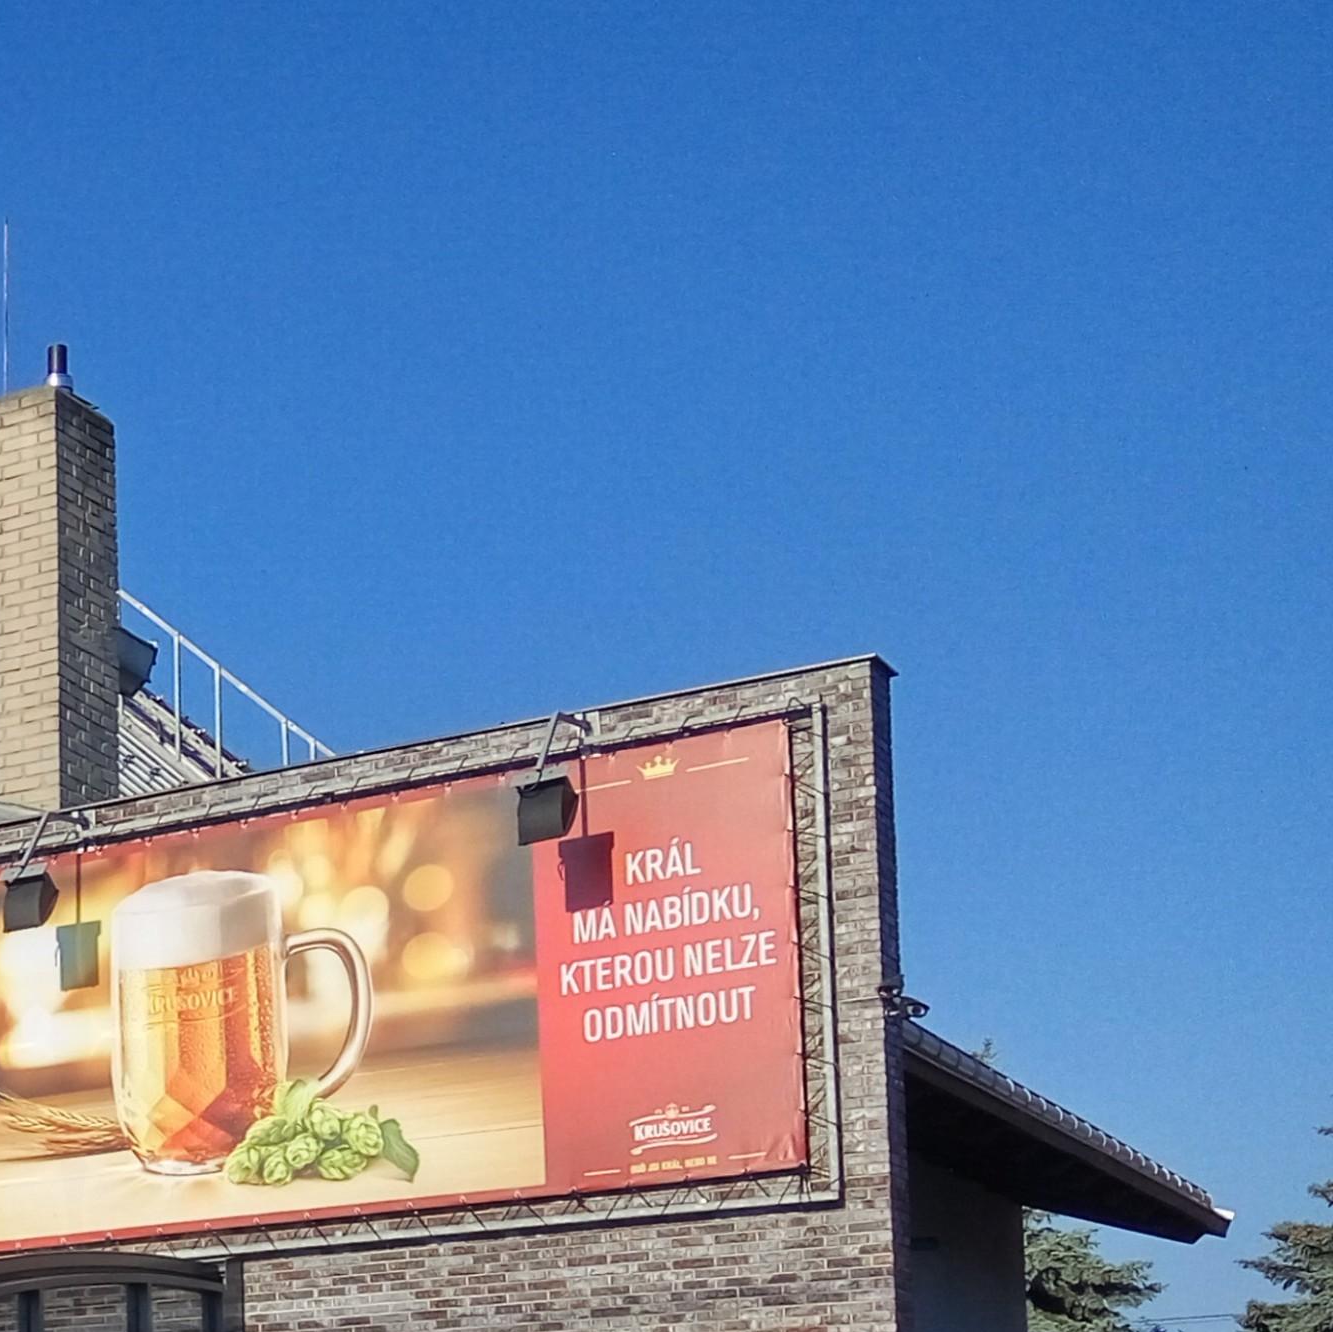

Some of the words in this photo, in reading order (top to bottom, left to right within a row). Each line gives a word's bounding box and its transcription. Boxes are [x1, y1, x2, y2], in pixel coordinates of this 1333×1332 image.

[625, 838, 701, 885] KRÁL
[572, 903, 616, 944] MÁ
[624, 884, 760, 935] NABÍDKU,
[559, 949, 675, 996] KTEROU
[684, 930, 777, 975] NELZE
[583, 986, 755, 1043] ODMÍTNOUT
[634, 1117, 712, 1142] KRUŠOVICE
